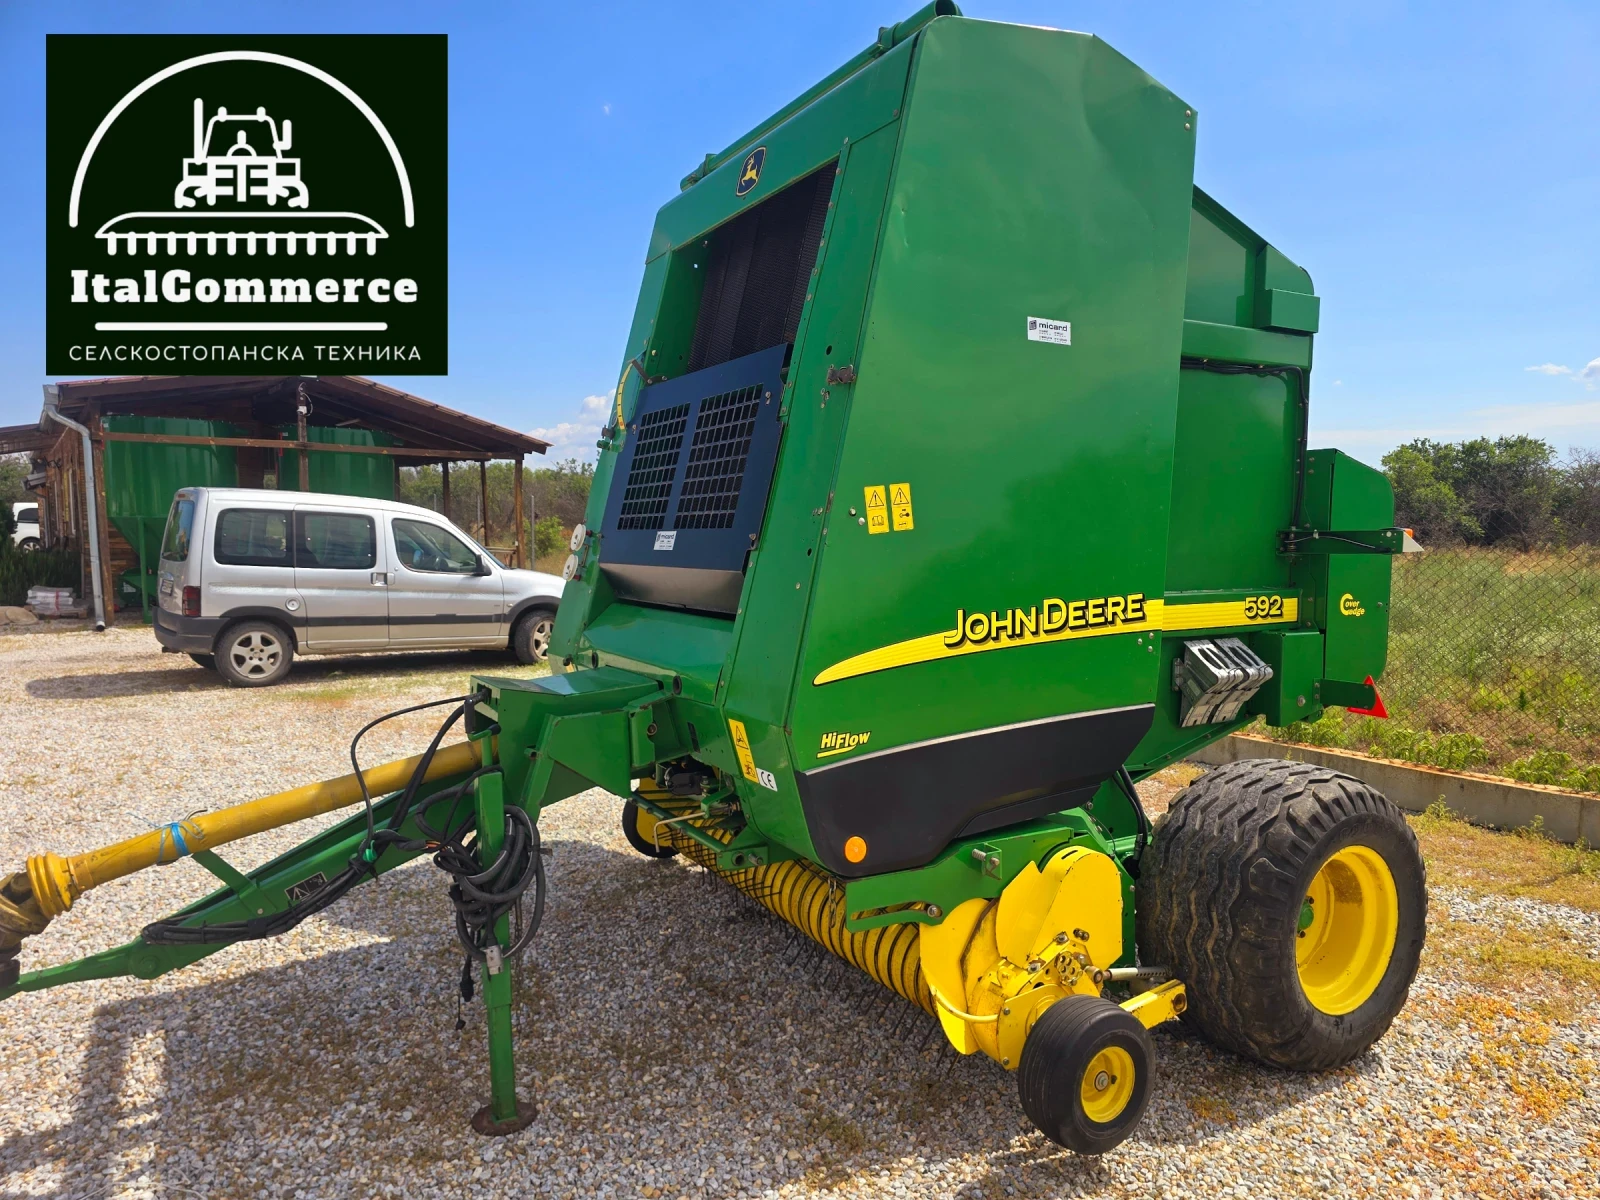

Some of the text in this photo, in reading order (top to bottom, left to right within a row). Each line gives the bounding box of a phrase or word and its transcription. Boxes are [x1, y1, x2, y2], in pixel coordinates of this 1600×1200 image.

[1038, 322, 1068, 332] micard
[1245, 595, 1283, 619] 592
[944, 593, 1146, 647] JOHN DEERE
